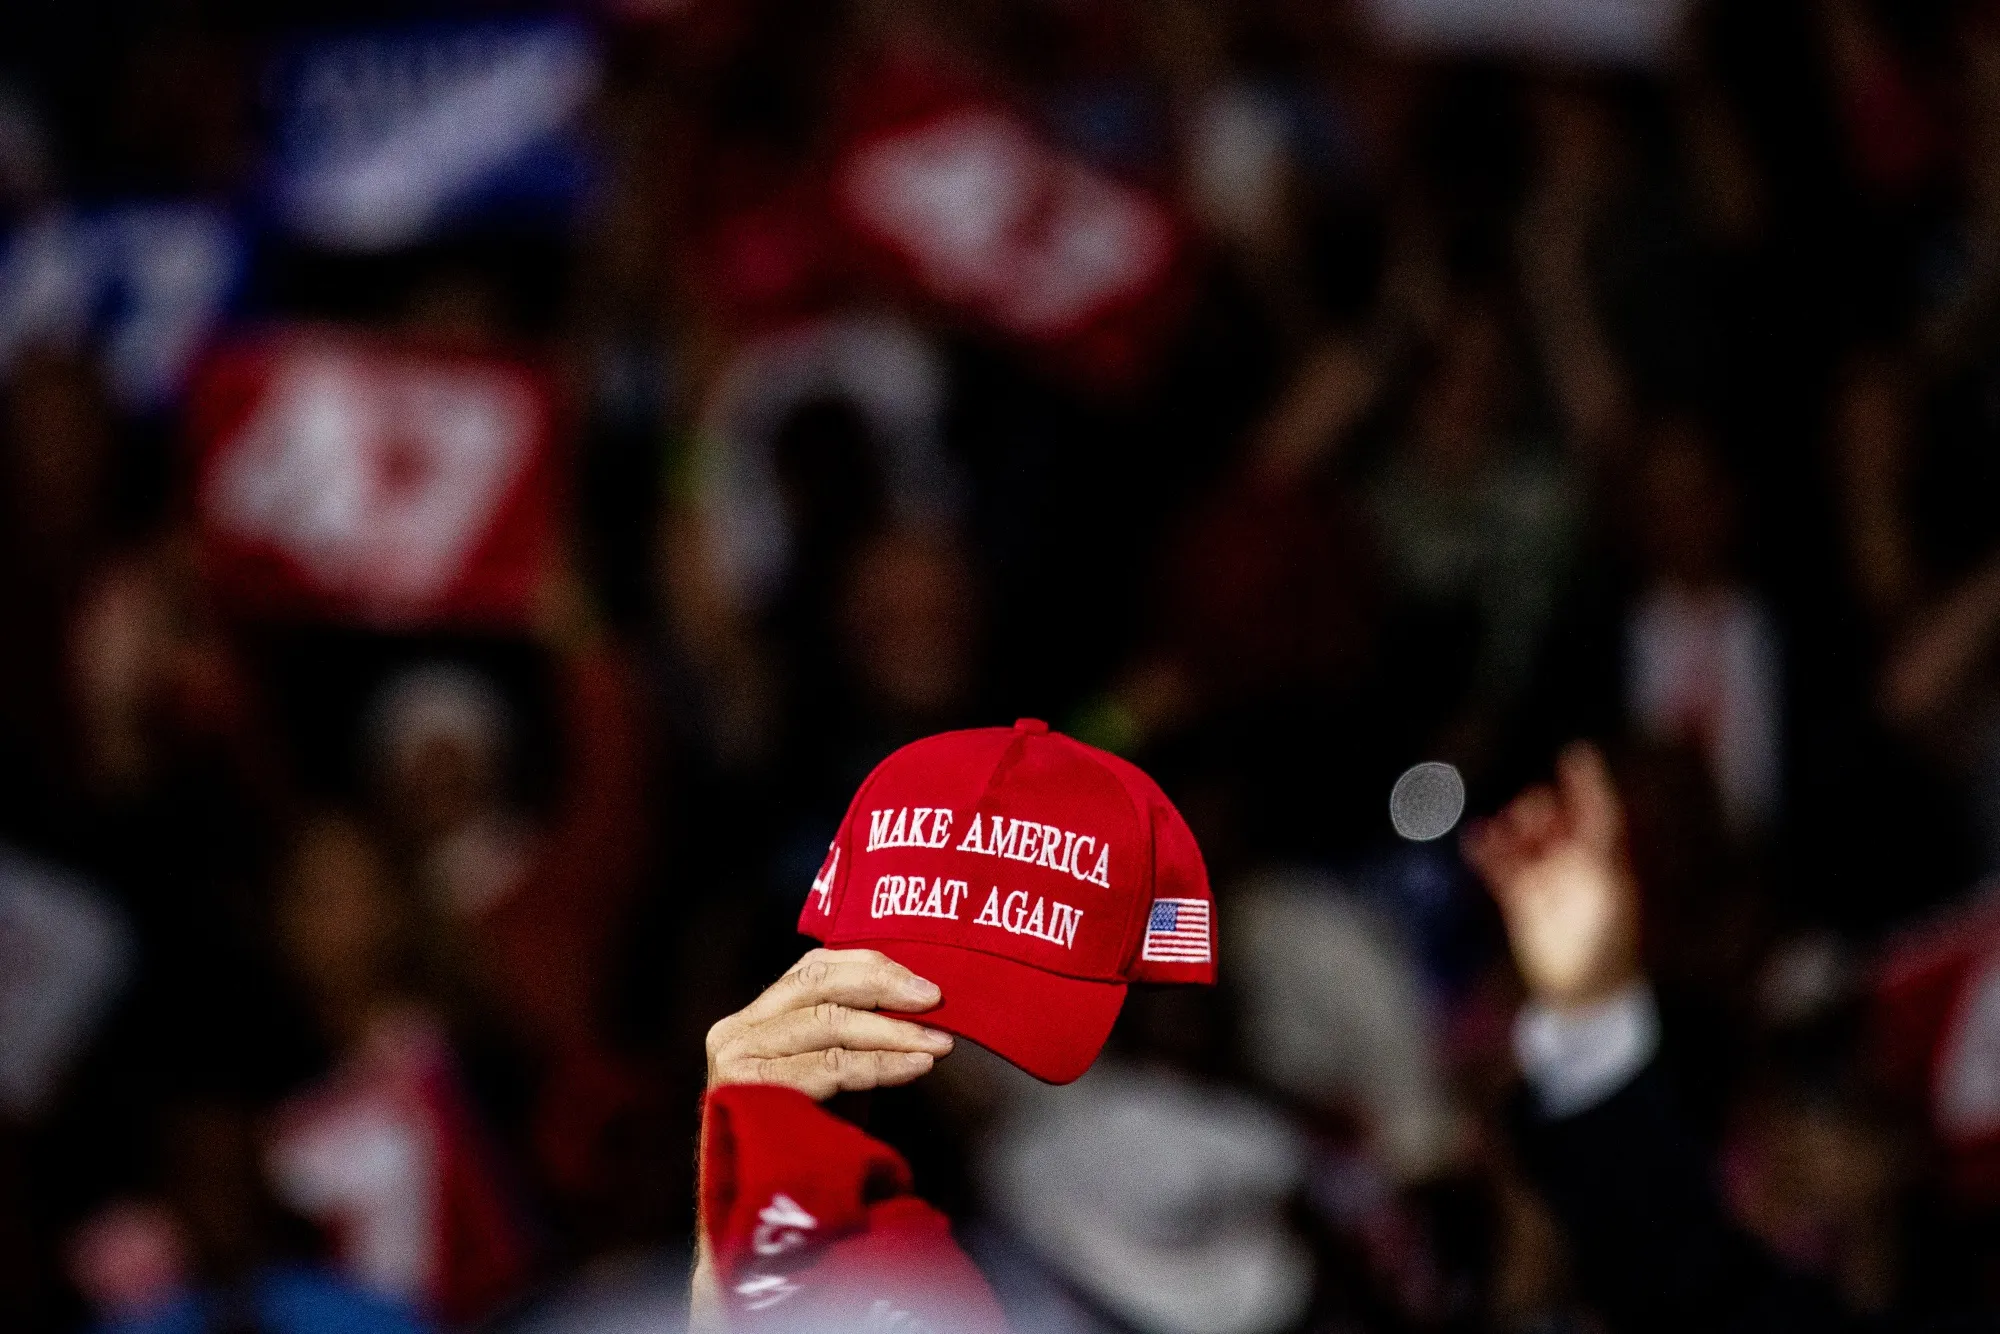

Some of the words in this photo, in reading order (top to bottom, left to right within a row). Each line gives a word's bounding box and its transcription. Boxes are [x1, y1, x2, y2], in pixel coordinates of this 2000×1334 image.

[865, 806, 953, 853] MAKE
[955, 811, 1111, 889] AMERICA
[870, 874, 969, 921] GREAT
[972, 885, 1085, 950] AGAIN
